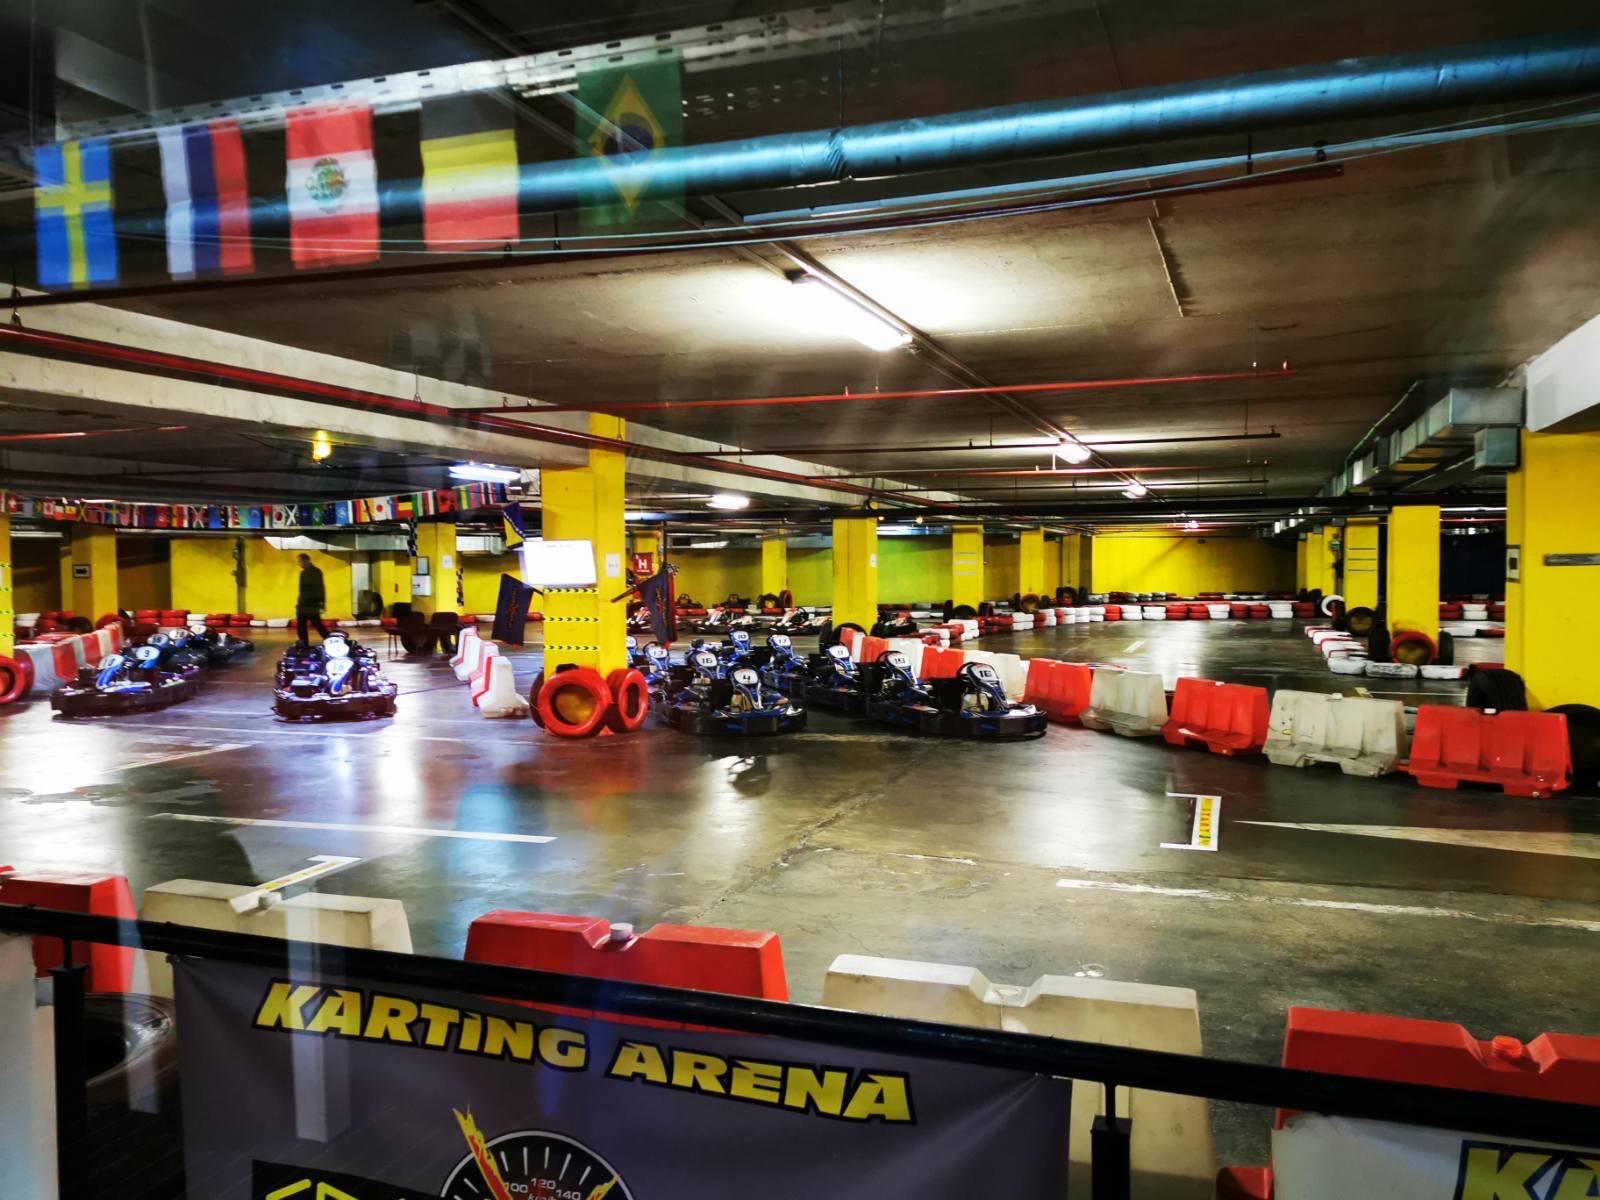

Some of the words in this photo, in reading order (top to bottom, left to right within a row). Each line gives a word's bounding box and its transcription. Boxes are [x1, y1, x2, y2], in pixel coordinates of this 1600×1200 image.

[610, 1039, 919, 1124] ARENA
[505, 1182, 528, 1194] 100
[530, 1177, 556, 1190] 120
[556, 1188, 581, 1200] 140
